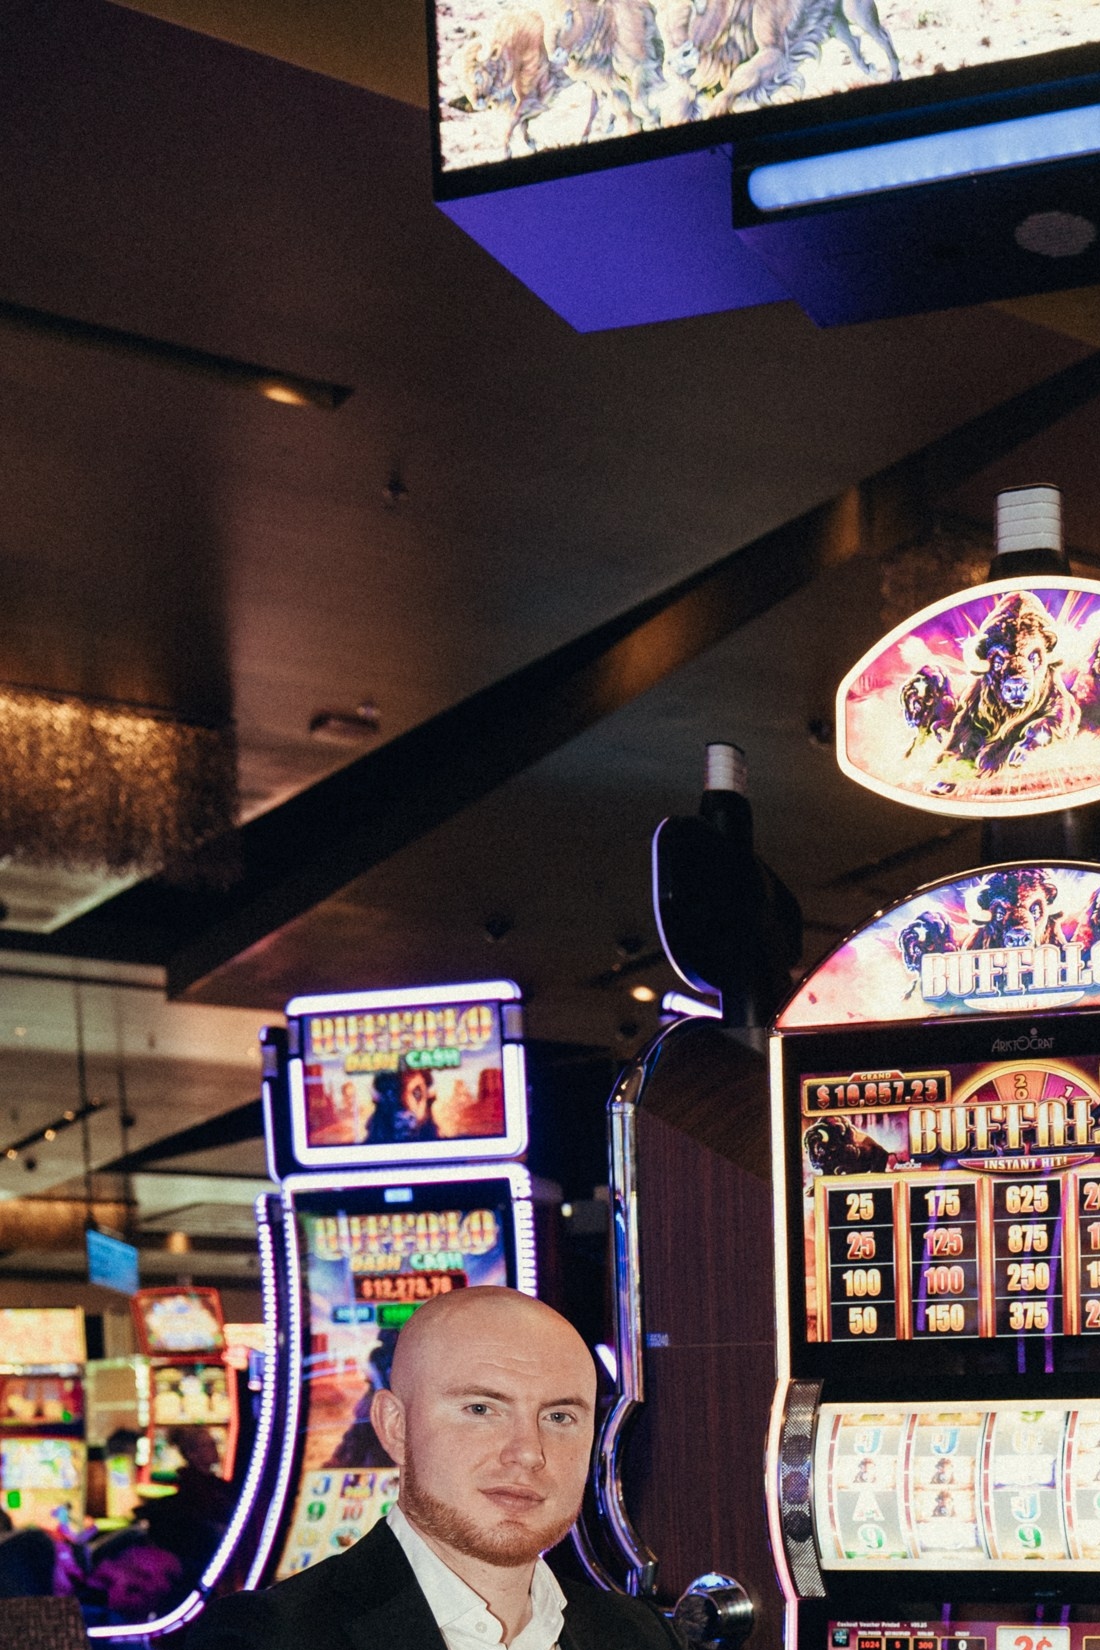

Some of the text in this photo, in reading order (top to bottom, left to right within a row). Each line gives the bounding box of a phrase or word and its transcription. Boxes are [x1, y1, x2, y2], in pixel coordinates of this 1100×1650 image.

[311, 1006, 494, 1060] BUFFALO
[991, 1029, 1056, 1053] ARISTOCRAT
[860, 1072, 892, 1081] GRAND
[983, 1155, 1068, 1170] INSTANT HIT!
[846, 1192, 875, 1221] 25
[924, 1188, 961, 1217] 175
[1005, 1185, 1049, 1214] 625
[313, 1210, 498, 1260] BUFFALO
[846, 1231, 876, 1260] 25
[922, 1227, 964, 1257] 125
[1007, 1224, 1049, 1253] 875
[842, 1268, 882, 1297] 100
[923, 1265, 965, 1294] 100
[1007, 1262, 1050, 1291] 250
[848, 1306, 878, 1335] 50
[925, 1303, 965, 1332] 150
[1009, 1301, 1050, 1330] 375
[1014, 1523, 1044, 1551] 9
[860, 1640, 880, 1649] 1024
[917, 1641, 934, 1650] 300
